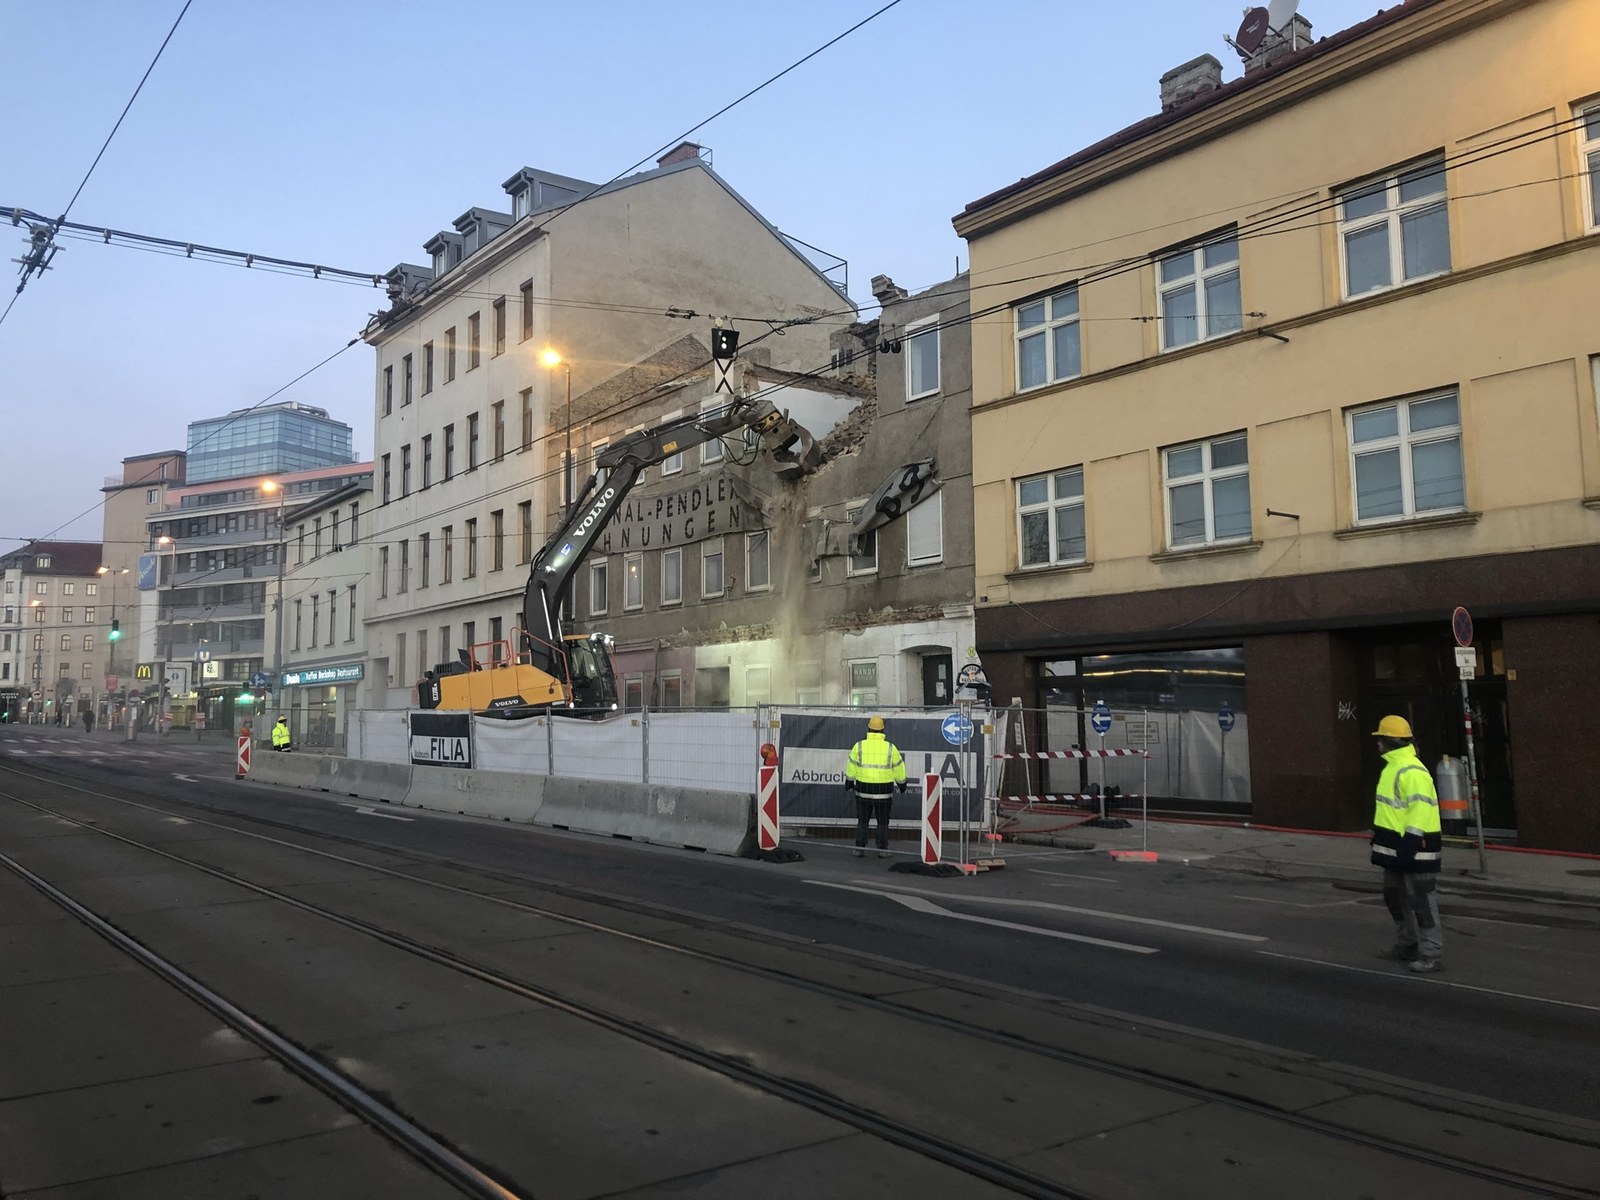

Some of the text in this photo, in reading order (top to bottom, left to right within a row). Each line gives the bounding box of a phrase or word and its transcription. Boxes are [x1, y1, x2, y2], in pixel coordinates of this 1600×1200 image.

[573, 487, 615, 537] VOLVO
[603, 504, 740, 552] HNUNGEN
[199, 651, 210, 661] U
[854, 668, 876, 676] HANDY
[495, 699, 519, 707] VOLVO
[430, 737, 465, 761] FILIA
[791, 769, 847, 783] Abbruch
